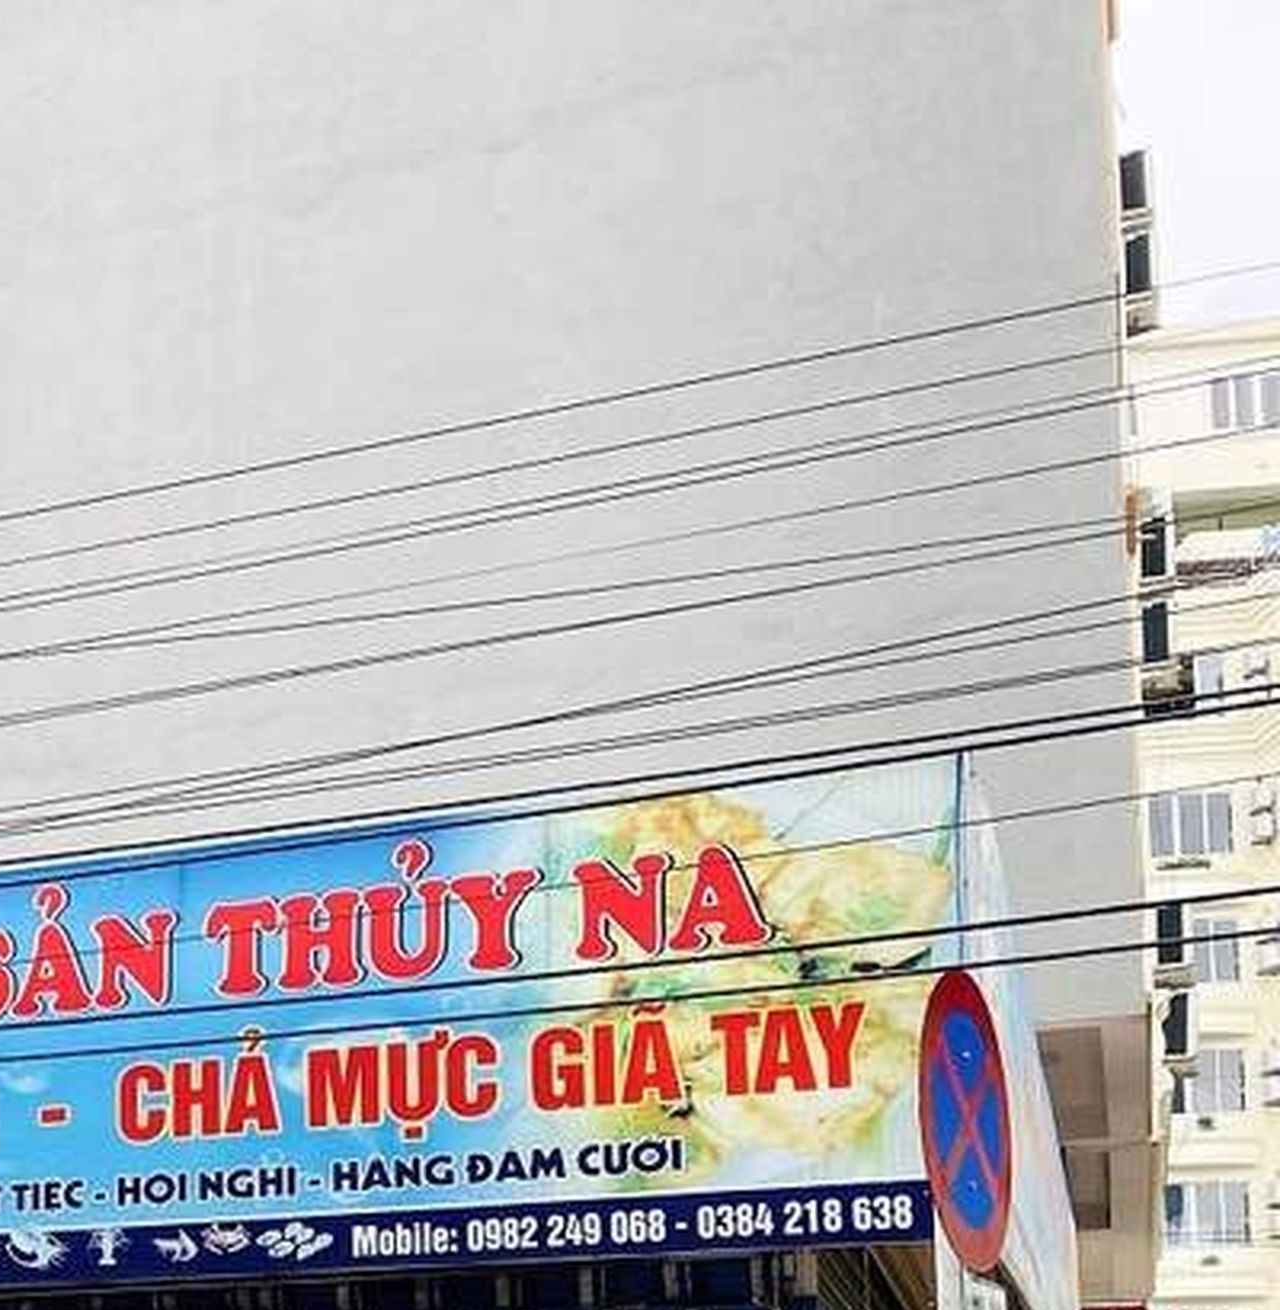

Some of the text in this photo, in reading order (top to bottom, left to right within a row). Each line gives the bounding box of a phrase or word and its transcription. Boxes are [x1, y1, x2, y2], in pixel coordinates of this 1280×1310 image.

[207, 836, 543, 1000] THỦY
[572, 844, 776, 963] NA
[119, 1025, 280, 1142] CHẢ
[307, 1029, 499, 1140] MỰC
[531, 996, 688, 1114] GIÃ
[711, 1000, 868, 1098] TAY
[351, 1218, 461, 1259] Mobile:
[466, 1217, 539, 1254] 0982
[545, 1213, 603, 1249] 249
[608, 1208, 667, 1245] 068
[695, 1202, 775, 1240] 0384
[782, 1198, 843, 1235] 218
[850, 1194, 915, 1231] 638
